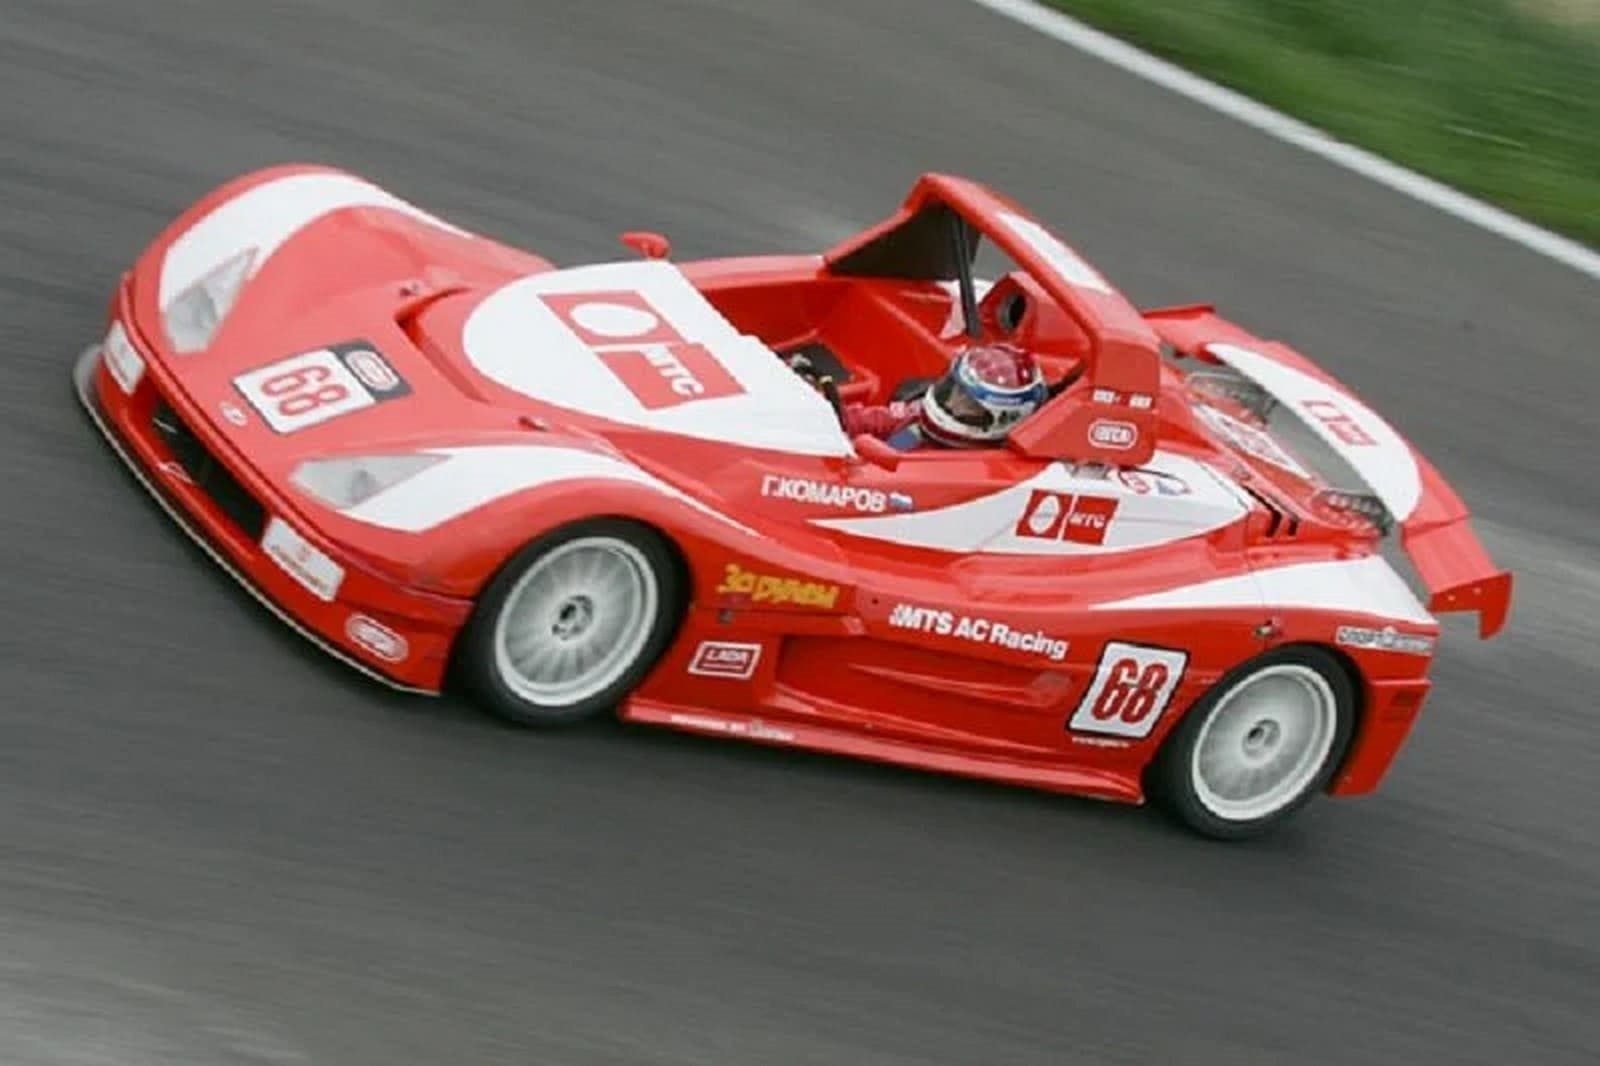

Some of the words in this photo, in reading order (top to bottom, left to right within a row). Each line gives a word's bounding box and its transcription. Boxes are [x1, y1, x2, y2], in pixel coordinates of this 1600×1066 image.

[260, 362, 350, 417] 68
[989, 623, 1069, 660] Racing
[1091, 657, 1170, 725] 68
